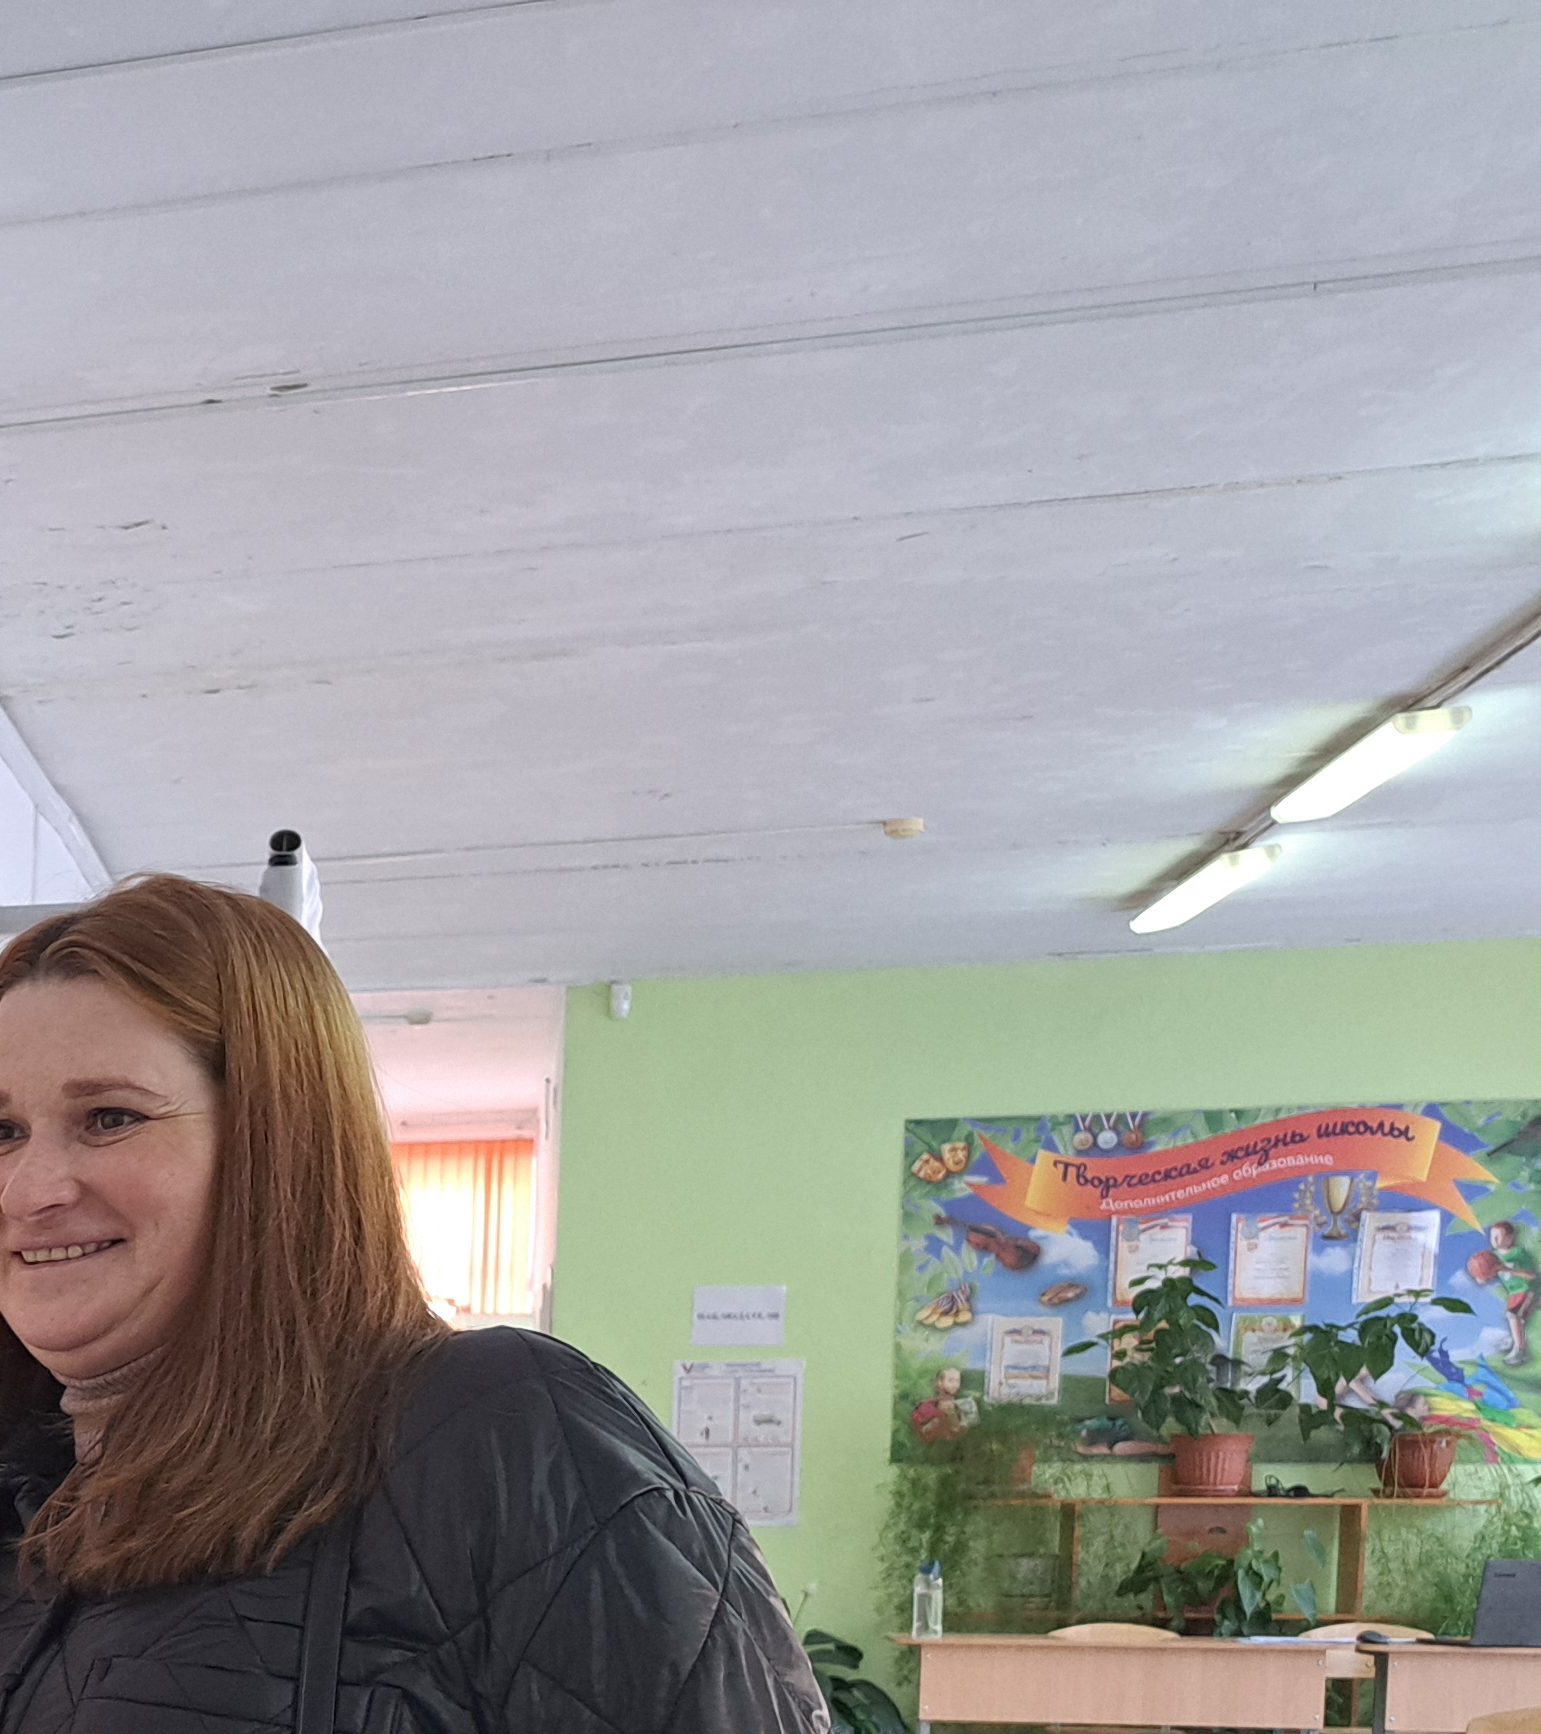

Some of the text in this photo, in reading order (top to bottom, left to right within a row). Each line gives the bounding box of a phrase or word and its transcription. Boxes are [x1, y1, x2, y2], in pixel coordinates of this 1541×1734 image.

[1053, 1120, 1416, 1199] Творческая жизнь школы
[1100, 1153, 1334, 1211] Дополнительное образование
